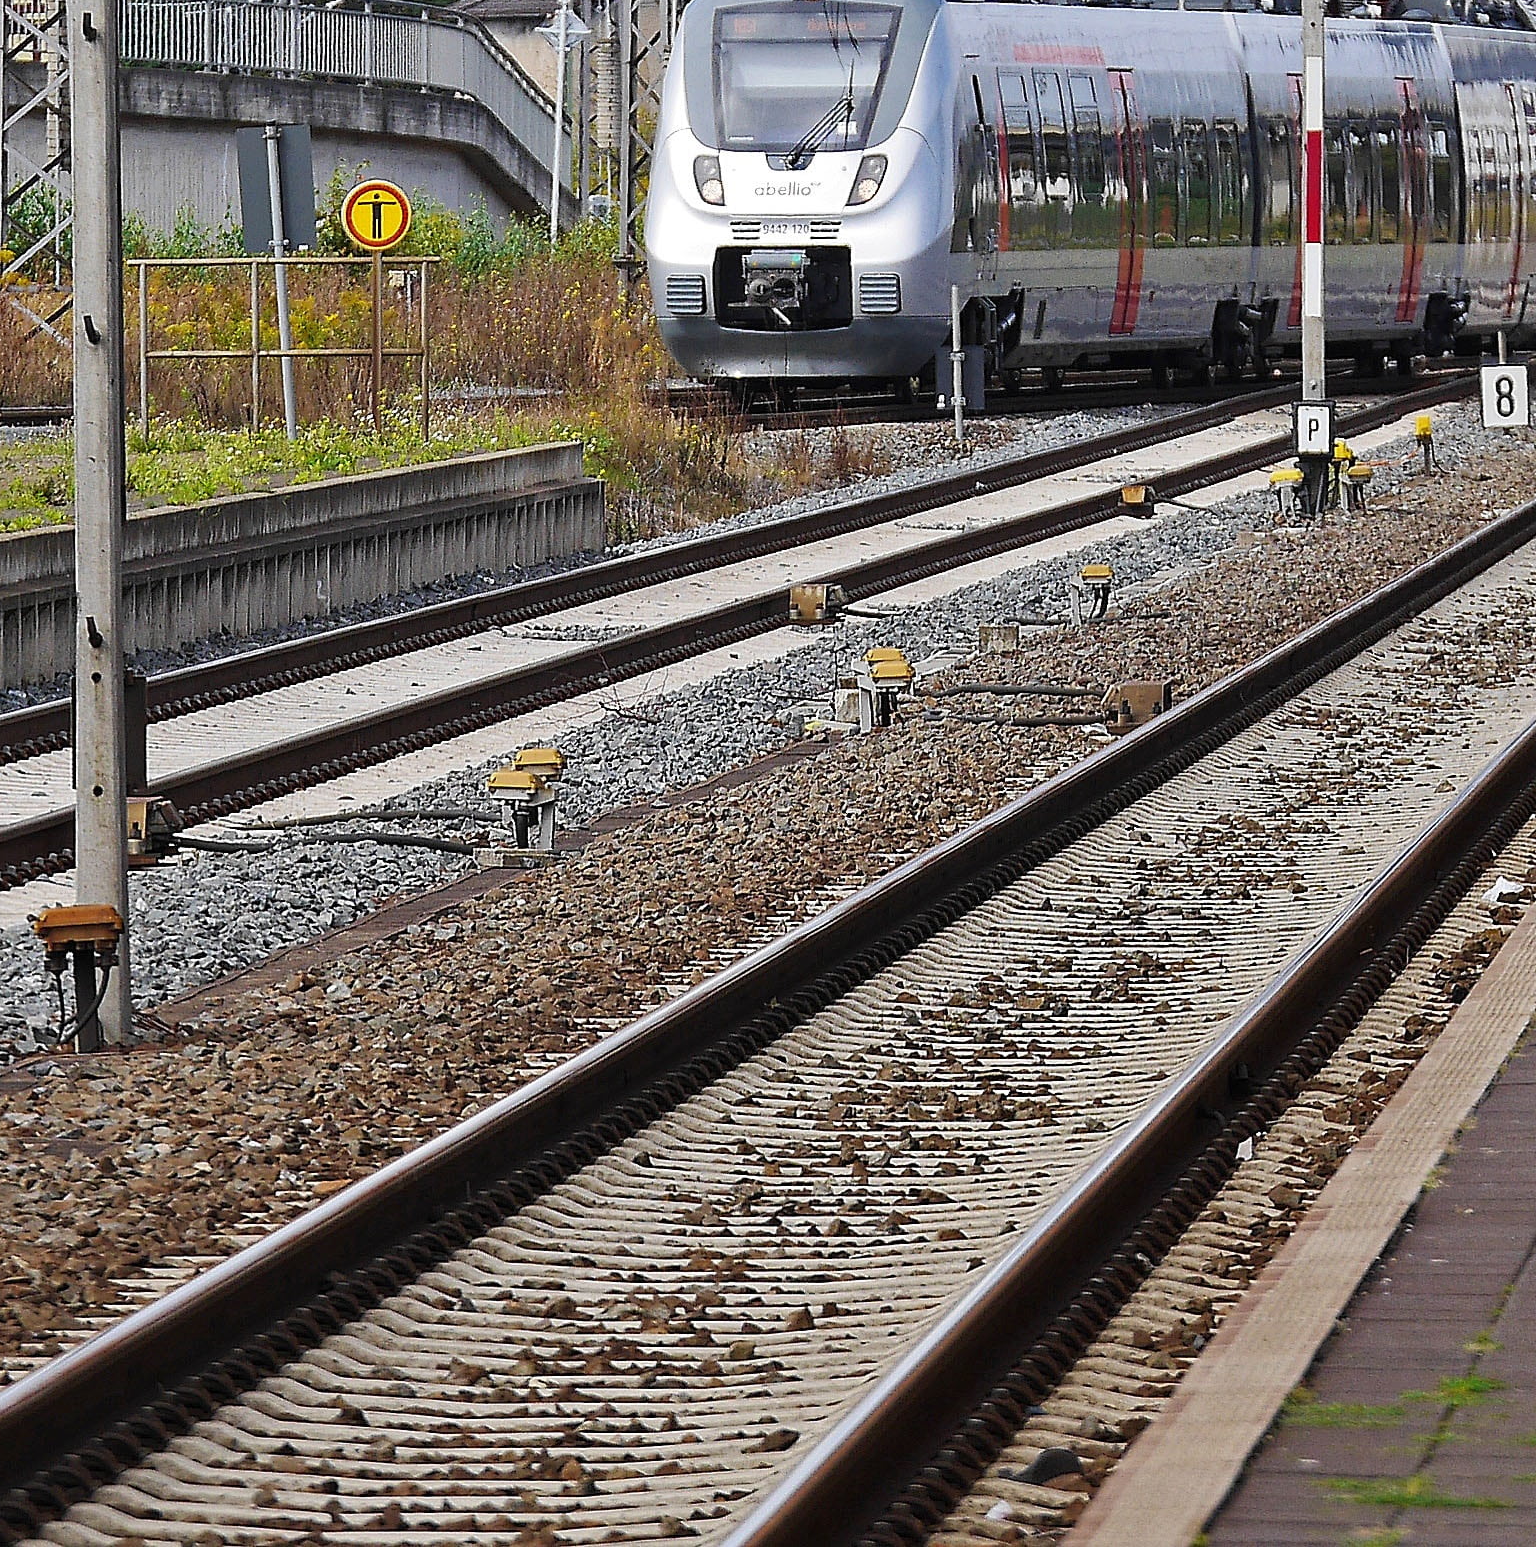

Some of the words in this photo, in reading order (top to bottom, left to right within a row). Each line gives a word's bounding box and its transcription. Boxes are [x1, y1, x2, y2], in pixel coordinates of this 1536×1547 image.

[754, 180, 812, 196] abellio
[762, 223, 788, 235] 9442
[792, 223, 810, 235] 120
[1495, 374, 1514, 418] 8
[1308, 417, 1320, 442] P
